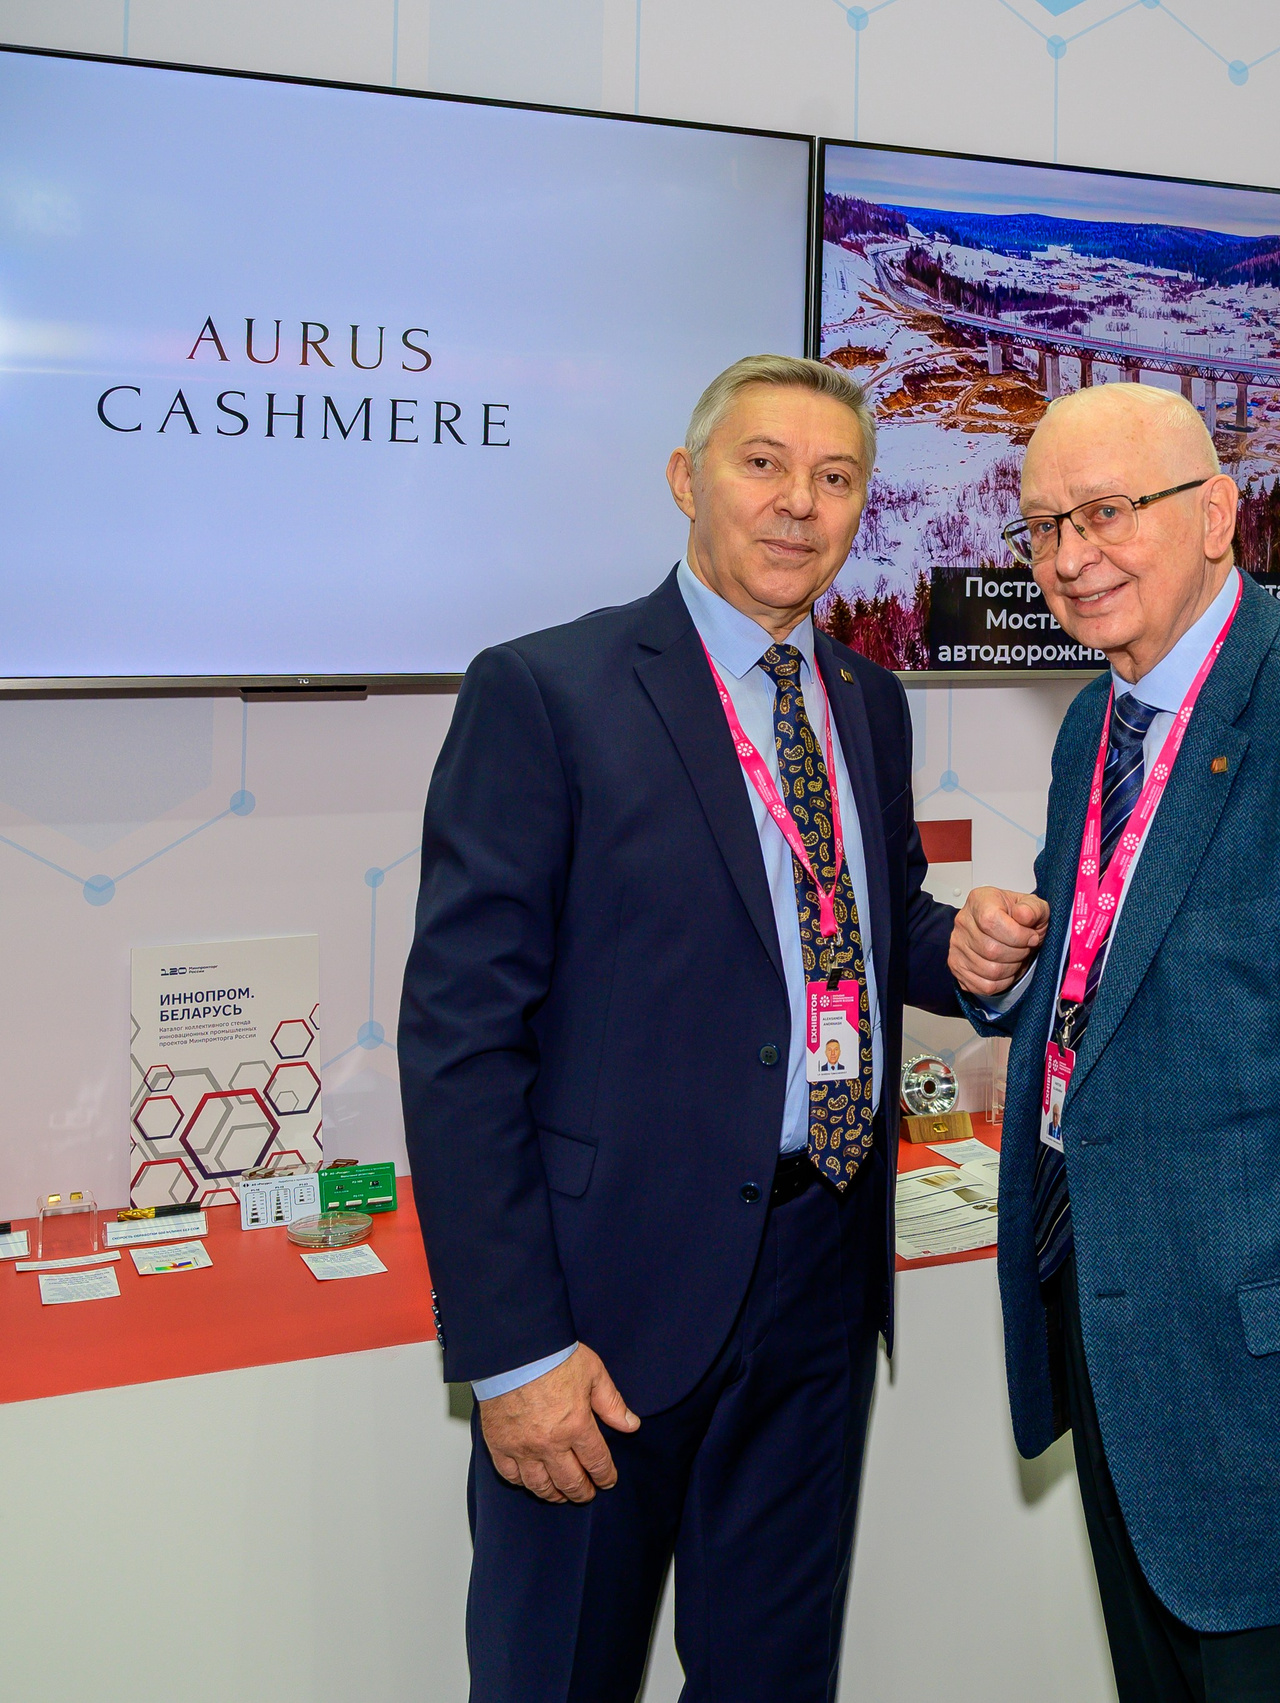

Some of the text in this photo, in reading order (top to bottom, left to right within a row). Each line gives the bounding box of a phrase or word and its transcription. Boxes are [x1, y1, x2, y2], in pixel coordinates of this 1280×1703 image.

[186, 315, 433, 373] AURUS
[97, 385, 511, 447] CASHMERE
[160, 987, 255, 1006] ИННОПРОМ.
[160, 1004, 242, 1022] БЕЛАРУСЬ
[159, 1025, 183, 1033] Каталог
[184, 1021, 230, 1031] коллективного
[159, 1026, 257, 1040] инновационных промышленных
[159, 1037, 188, 1047] проектов
[1045, 1054, 1053, 1106] EXHIBITOR
